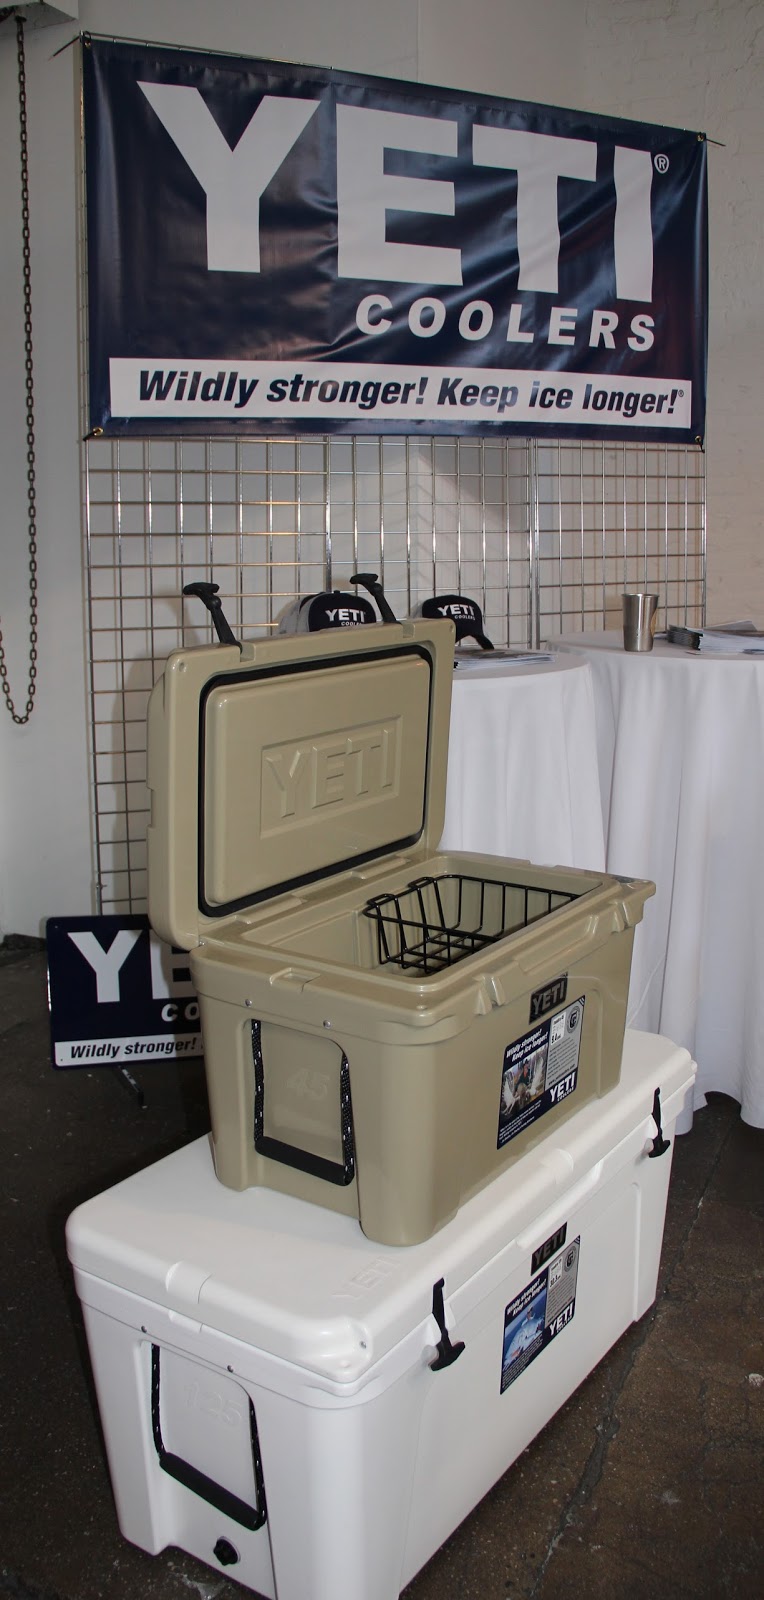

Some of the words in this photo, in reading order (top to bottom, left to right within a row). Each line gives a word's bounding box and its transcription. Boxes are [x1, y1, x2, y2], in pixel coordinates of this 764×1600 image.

[136, 80, 654, 303] YETI
[355, 294, 656, 352] COOLERS
[138, 370, 258, 405] Wildly
[266, 377, 428, 408] stronger!
[437, 378, 518, 414] Keep
[529, 380, 573, 410] ice
[325, 608, 365, 623] YETI
[437, 604, 475, 616] YETI
[266, 728, 395, 819] YETI
[532, 980, 565, 1016] YETI
[70, 1043, 120, 1059] Wildly
[124, 1037, 197, 1054] stronger!
[550, 1071, 576, 1103] YETI
[534, 1228, 565, 1266] YETI
[549, 1300, 574, 1336] YETI
